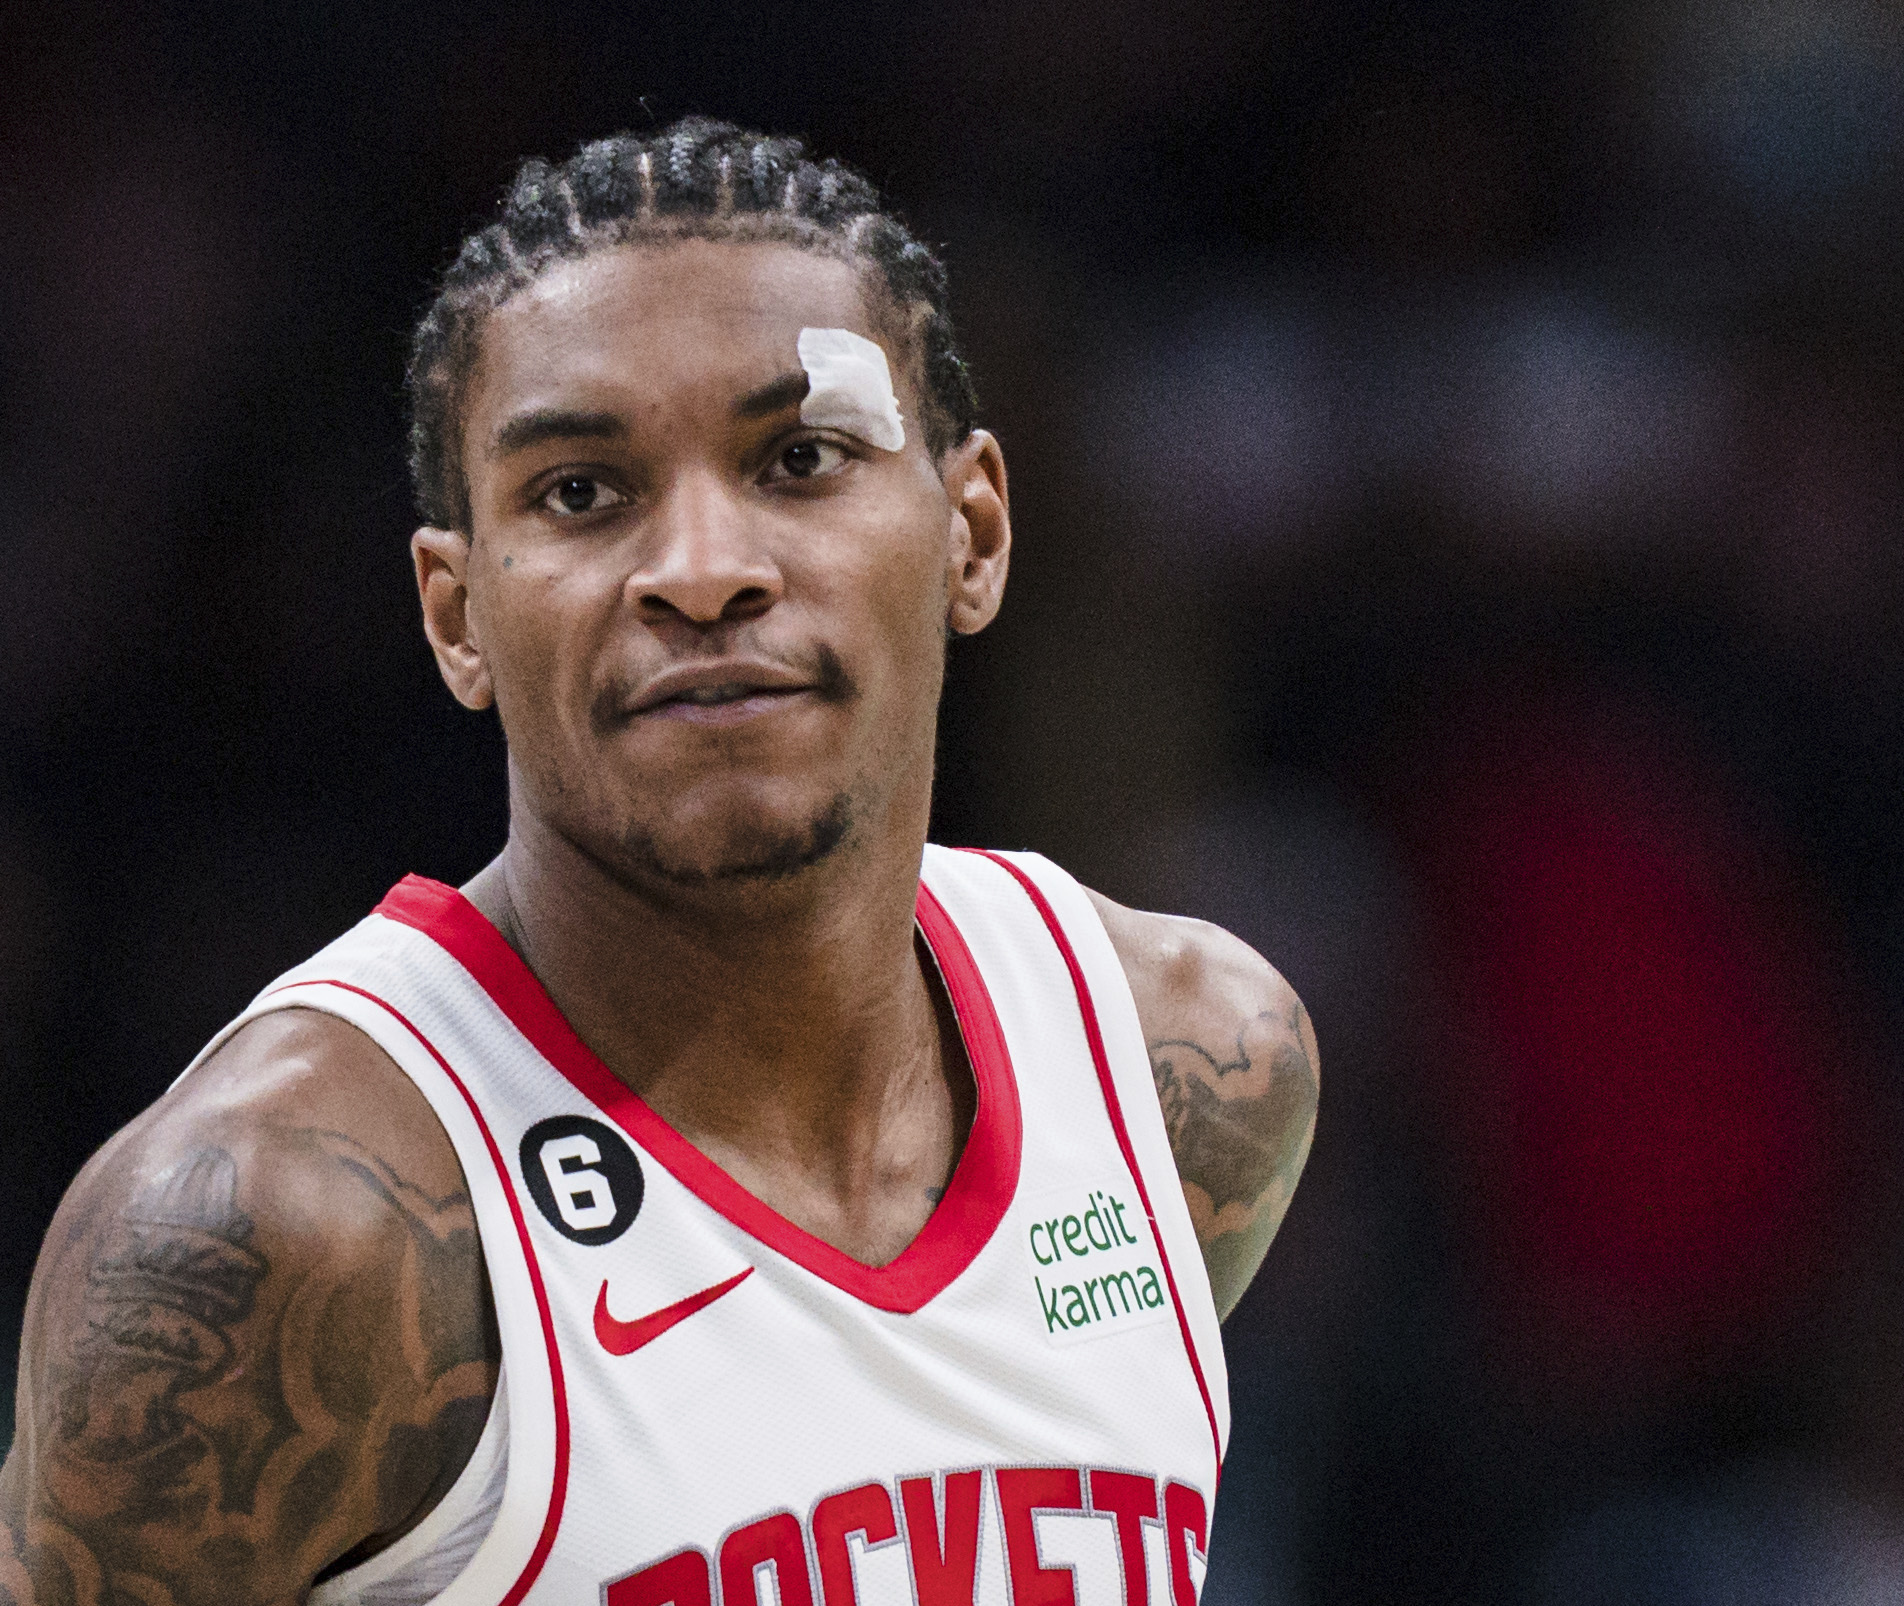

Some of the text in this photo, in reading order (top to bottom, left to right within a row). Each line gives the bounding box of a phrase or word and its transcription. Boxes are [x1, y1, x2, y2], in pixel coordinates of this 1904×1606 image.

[539, 1134, 617, 1231] 6
[1030, 1190, 1137, 1266] credit
[1034, 1266, 1164, 1333] karma
